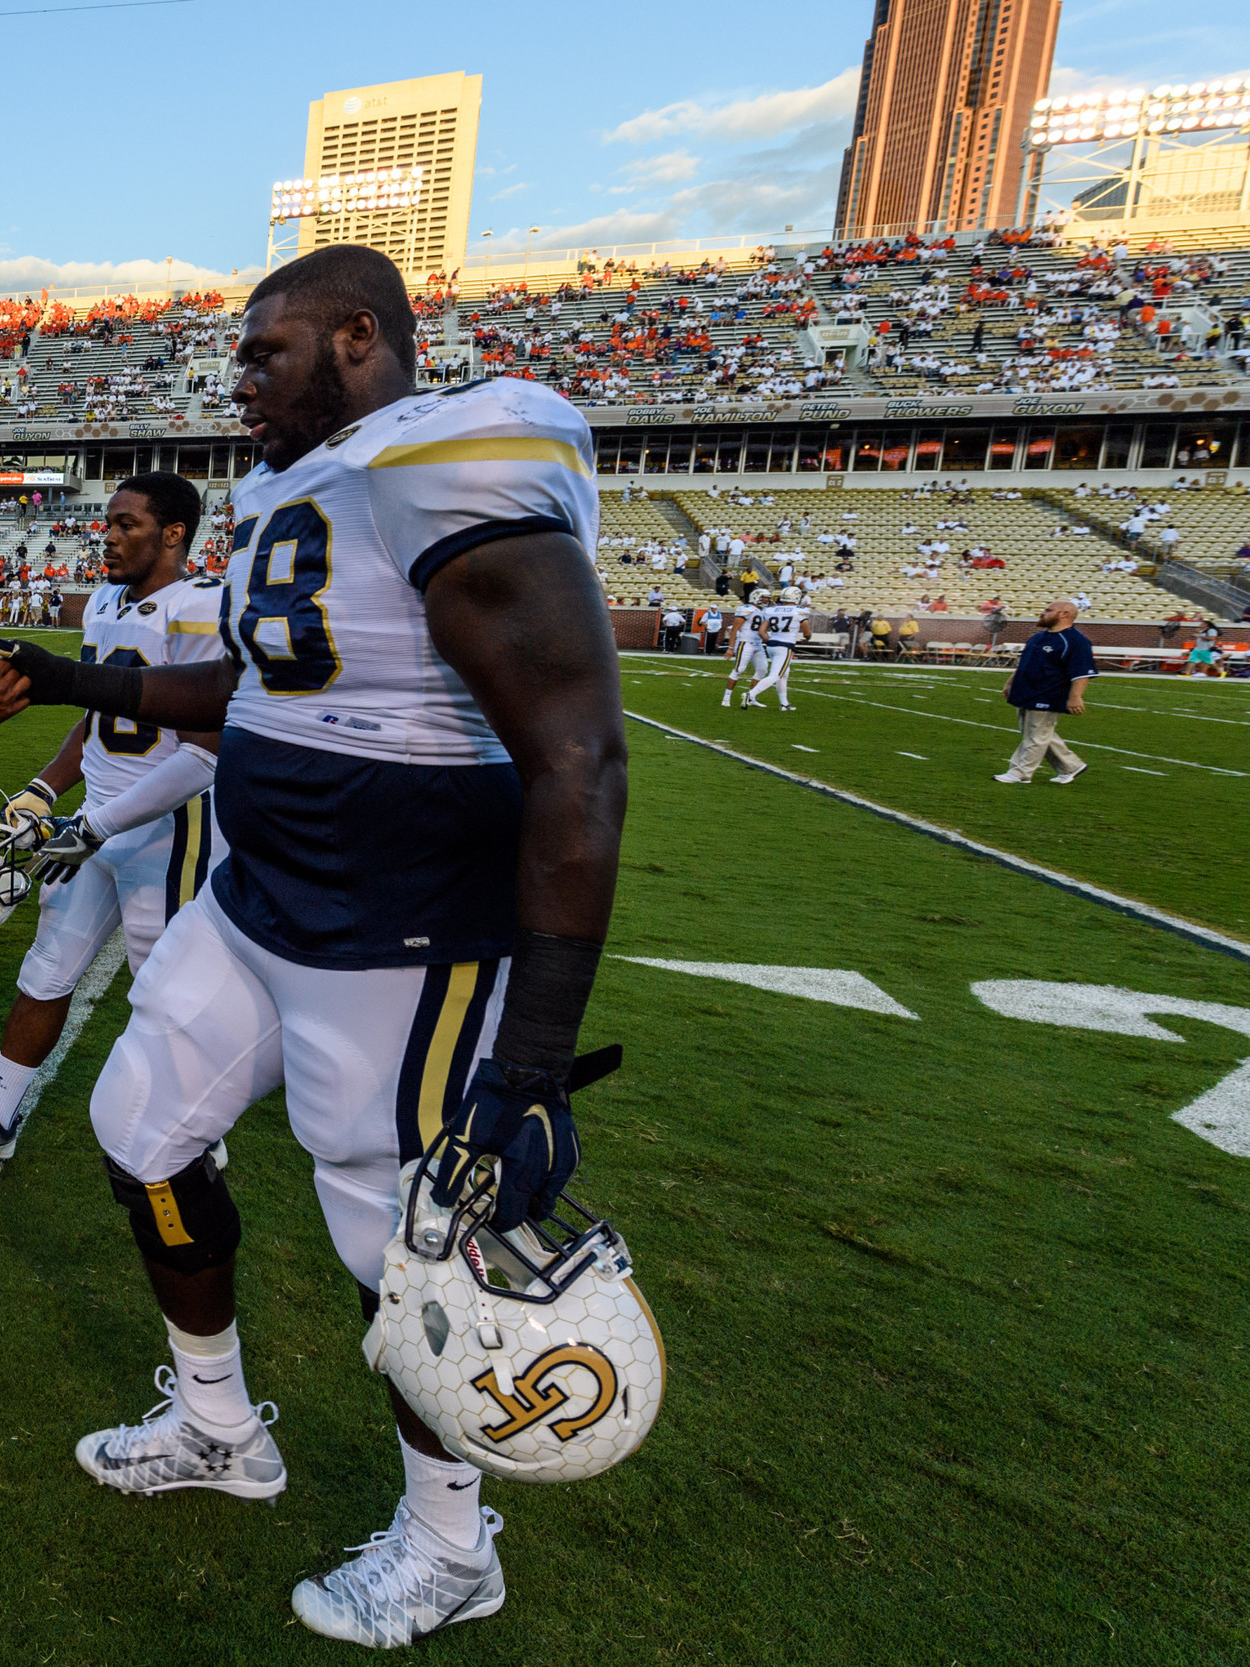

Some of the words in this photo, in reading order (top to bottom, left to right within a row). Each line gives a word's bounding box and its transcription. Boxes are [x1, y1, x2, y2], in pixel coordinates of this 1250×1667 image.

[887, 400, 919, 408] BUCK
[1015, 397, 1040, 405] JOE
[628, 408, 664, 416] BOBBY
[693, 406, 714, 414] JOE
[884, 405, 972, 418] FLOWERS
[1012, 402, 1085, 414] GUYON
[626, 414, 674, 424] DAVIS
[691, 411, 778, 423] HAMILTON
[799, 409, 850, 420] PUND
[13, 432, 51, 440] GUYON
[129, 429, 166, 438] SHAW
[769, 616, 793, 632] 87
[470, 1342, 618, 1444] GT
